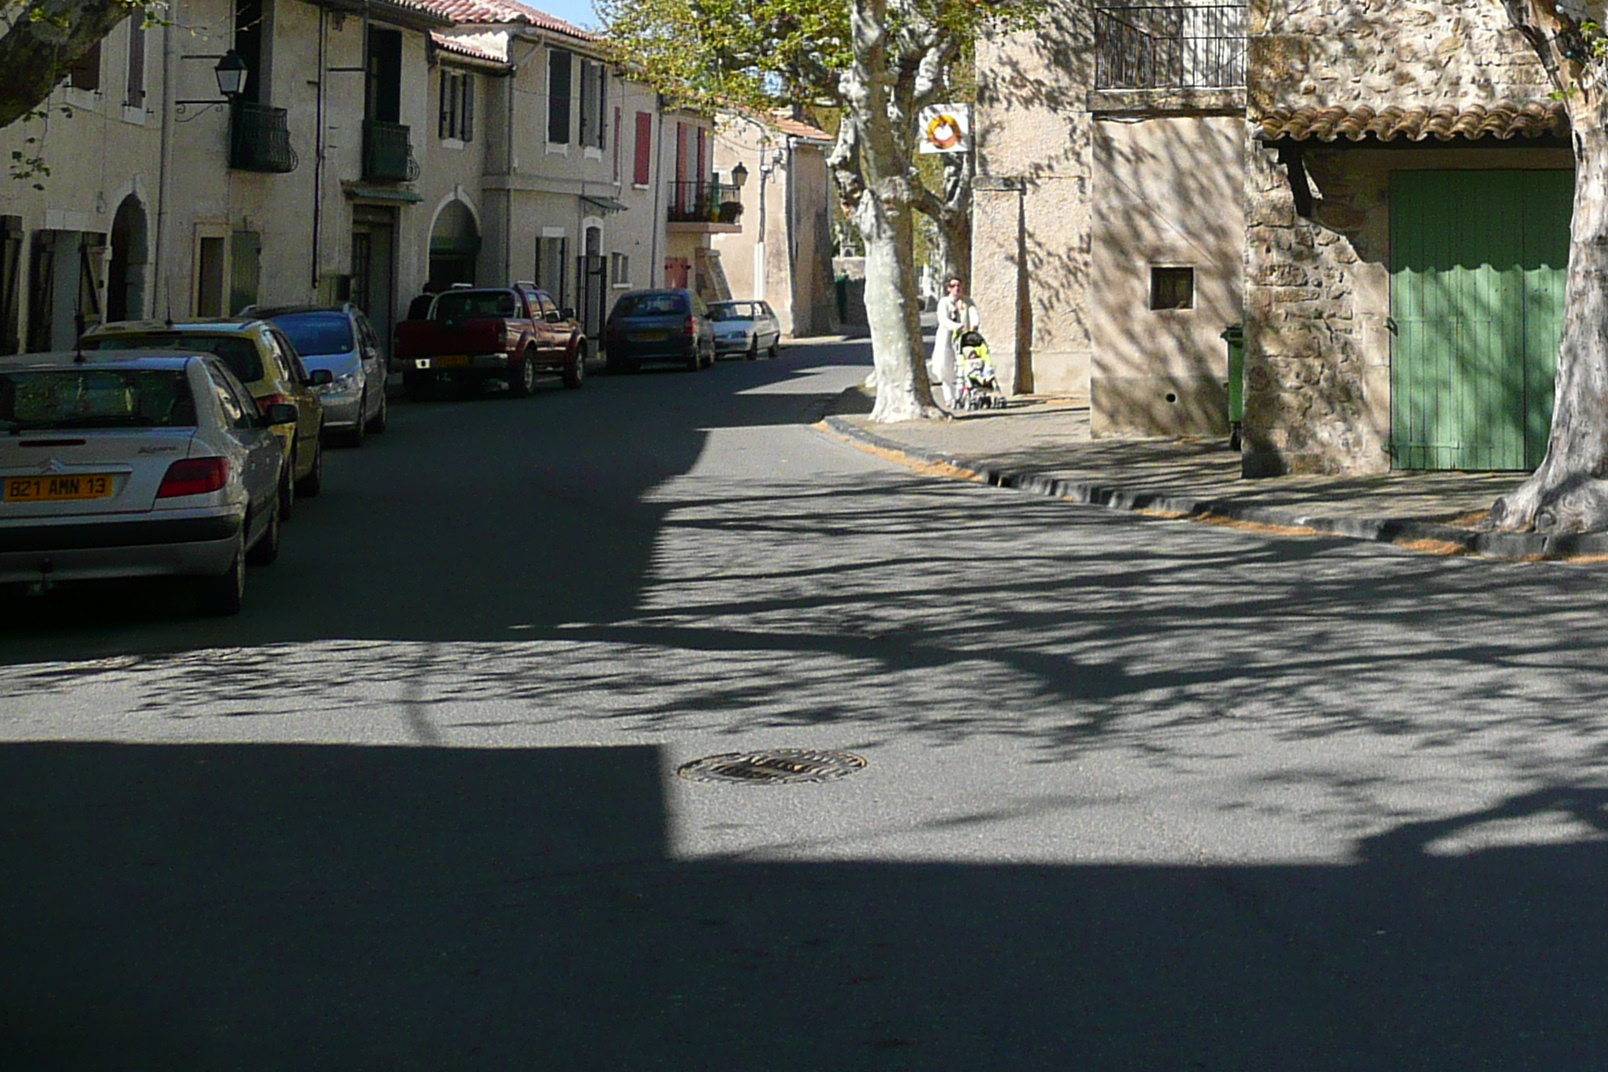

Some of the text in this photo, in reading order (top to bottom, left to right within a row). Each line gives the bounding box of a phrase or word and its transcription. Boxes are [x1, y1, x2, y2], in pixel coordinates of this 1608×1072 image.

[9, 477, 106, 498] 821 AMN 13
